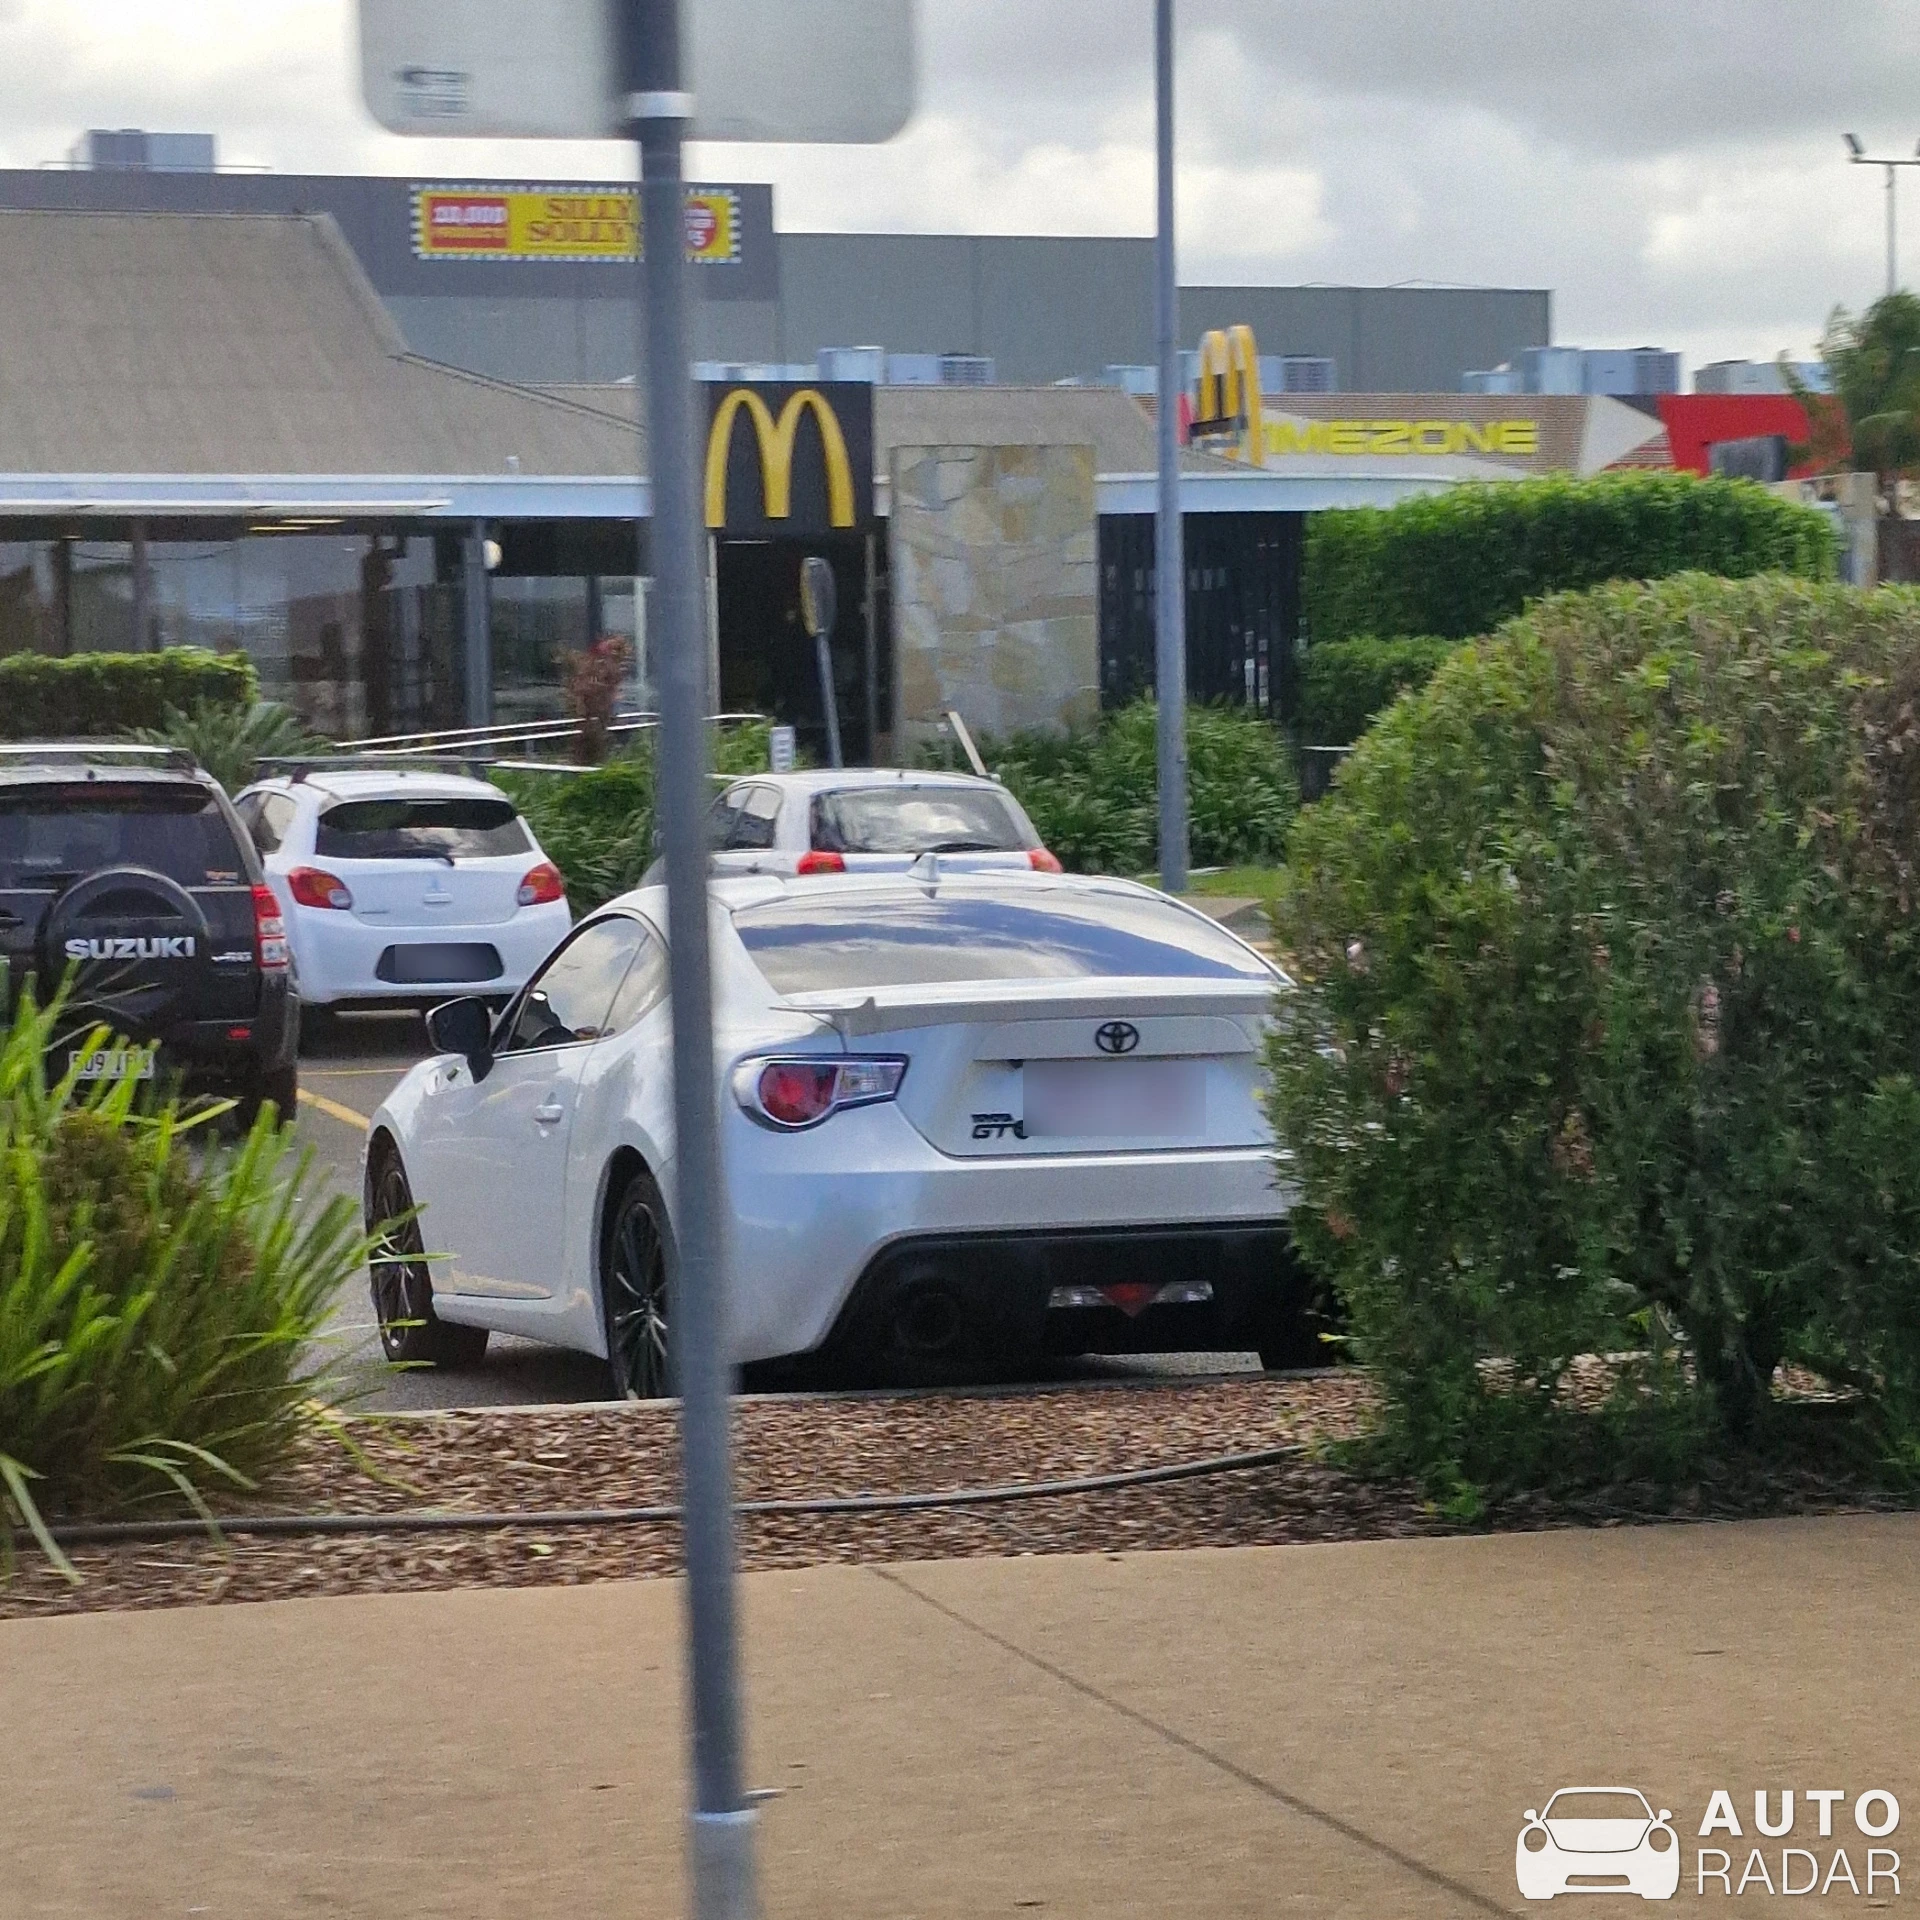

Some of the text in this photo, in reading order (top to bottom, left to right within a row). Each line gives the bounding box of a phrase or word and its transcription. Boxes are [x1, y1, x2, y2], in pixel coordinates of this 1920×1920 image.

[546, 198, 631, 220] SILLY
[527, 220, 640, 243] SOLLY
[1263, 419, 1538, 455] IMEZONE
[65, 936, 196, 960] SUZUKI
